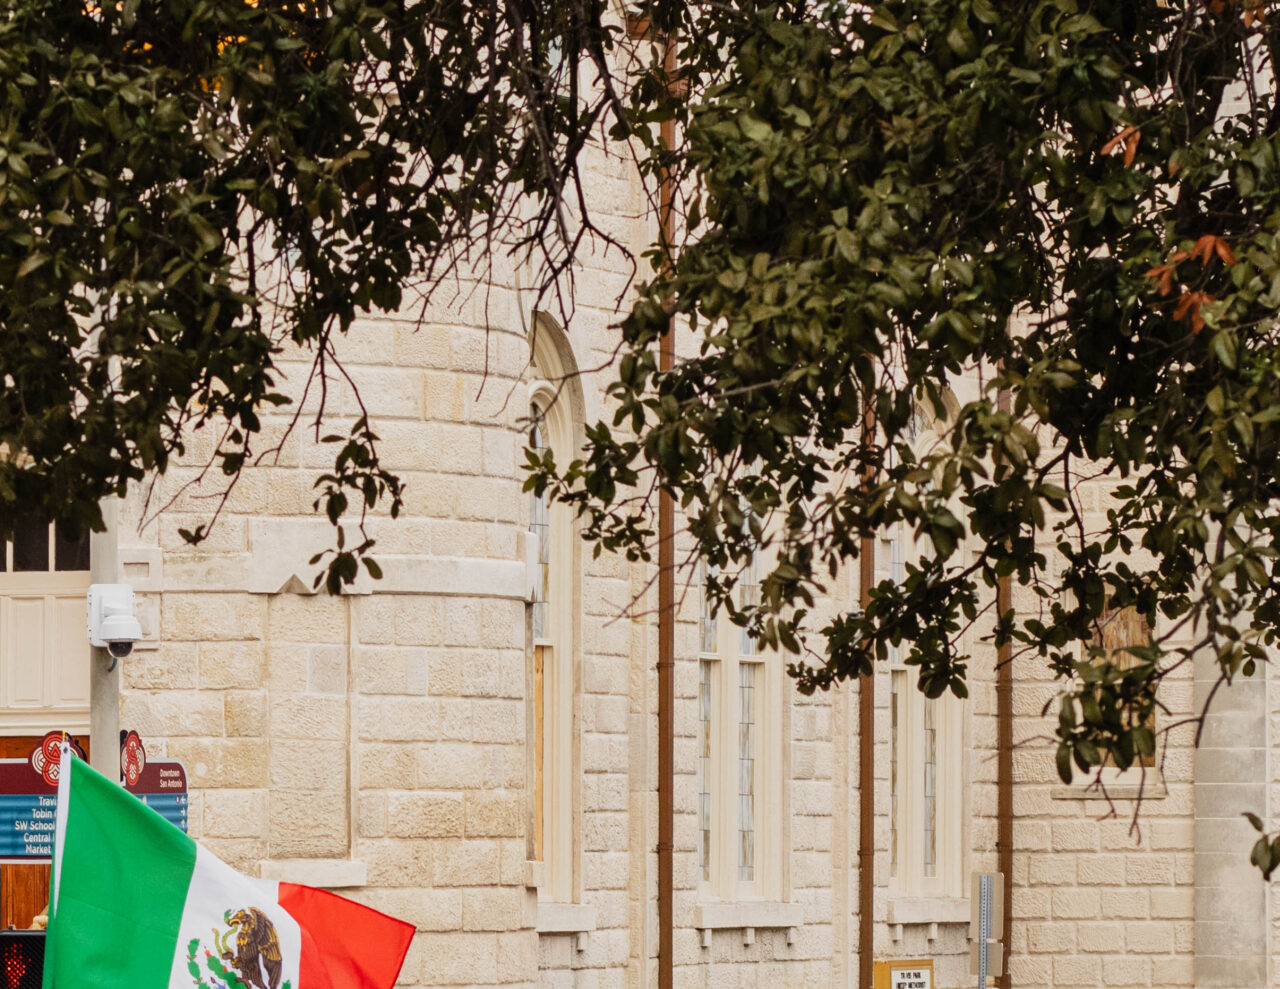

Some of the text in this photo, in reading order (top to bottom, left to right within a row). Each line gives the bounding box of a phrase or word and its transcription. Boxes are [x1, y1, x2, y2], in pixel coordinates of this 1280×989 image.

[159, 768, 180, 778] Downtown
[159, 779, 183, 788] San Antonio
[39, 797, 58, 806] Travi
[32, 808, 53, 818] Tobin
[15, 820, 28, 830] SW
[23, 832, 51, 842] Central
[25, 844, 51, 854] Market
